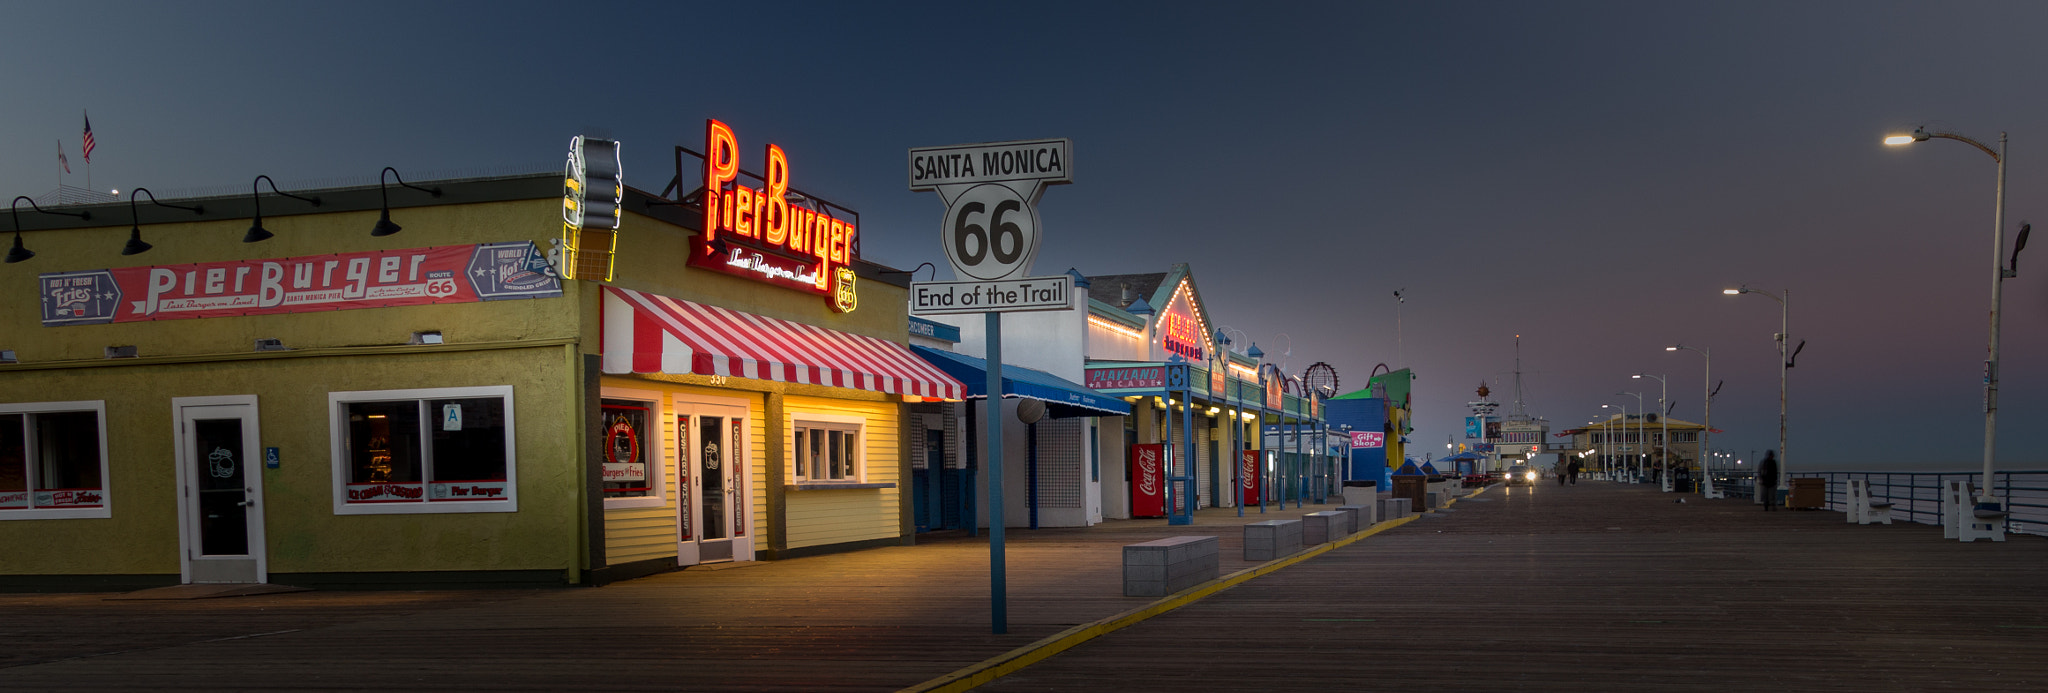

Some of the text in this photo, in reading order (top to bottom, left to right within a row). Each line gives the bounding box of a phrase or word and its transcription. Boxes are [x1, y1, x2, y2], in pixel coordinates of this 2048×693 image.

[914, 147, 1061, 180] SANTA MONICA
[954, 199, 1024, 266] 66
[497, 249, 522, 259] WORLD
[499, 261, 519, 284] Hot
[50, 279, 63, 288] HOT
[72, 277, 93, 286] FRESH
[428, 281, 453, 294] 66
[51, 287, 92, 308] Fries
[286, 292, 341, 302] SANTA MONICA PIER
[918, 281, 1062, 307] End of the Trail
[185, 299, 216, 309] Burger
[1093, 368, 1159, 381] PLAYLAND
[1095, 380, 1156, 388] ARCADE
[448, 408, 458, 422] A
[613, 423, 630, 434] PIER
[1354, 439, 1376, 448] Shop
[1357, 433, 1373, 441] Gift
[680, 423, 688, 477] CUSTARD
[602, 466, 625, 480] Burgers
[629, 466, 643, 477] Fries
[451, 486, 504, 497] Pier Burger
